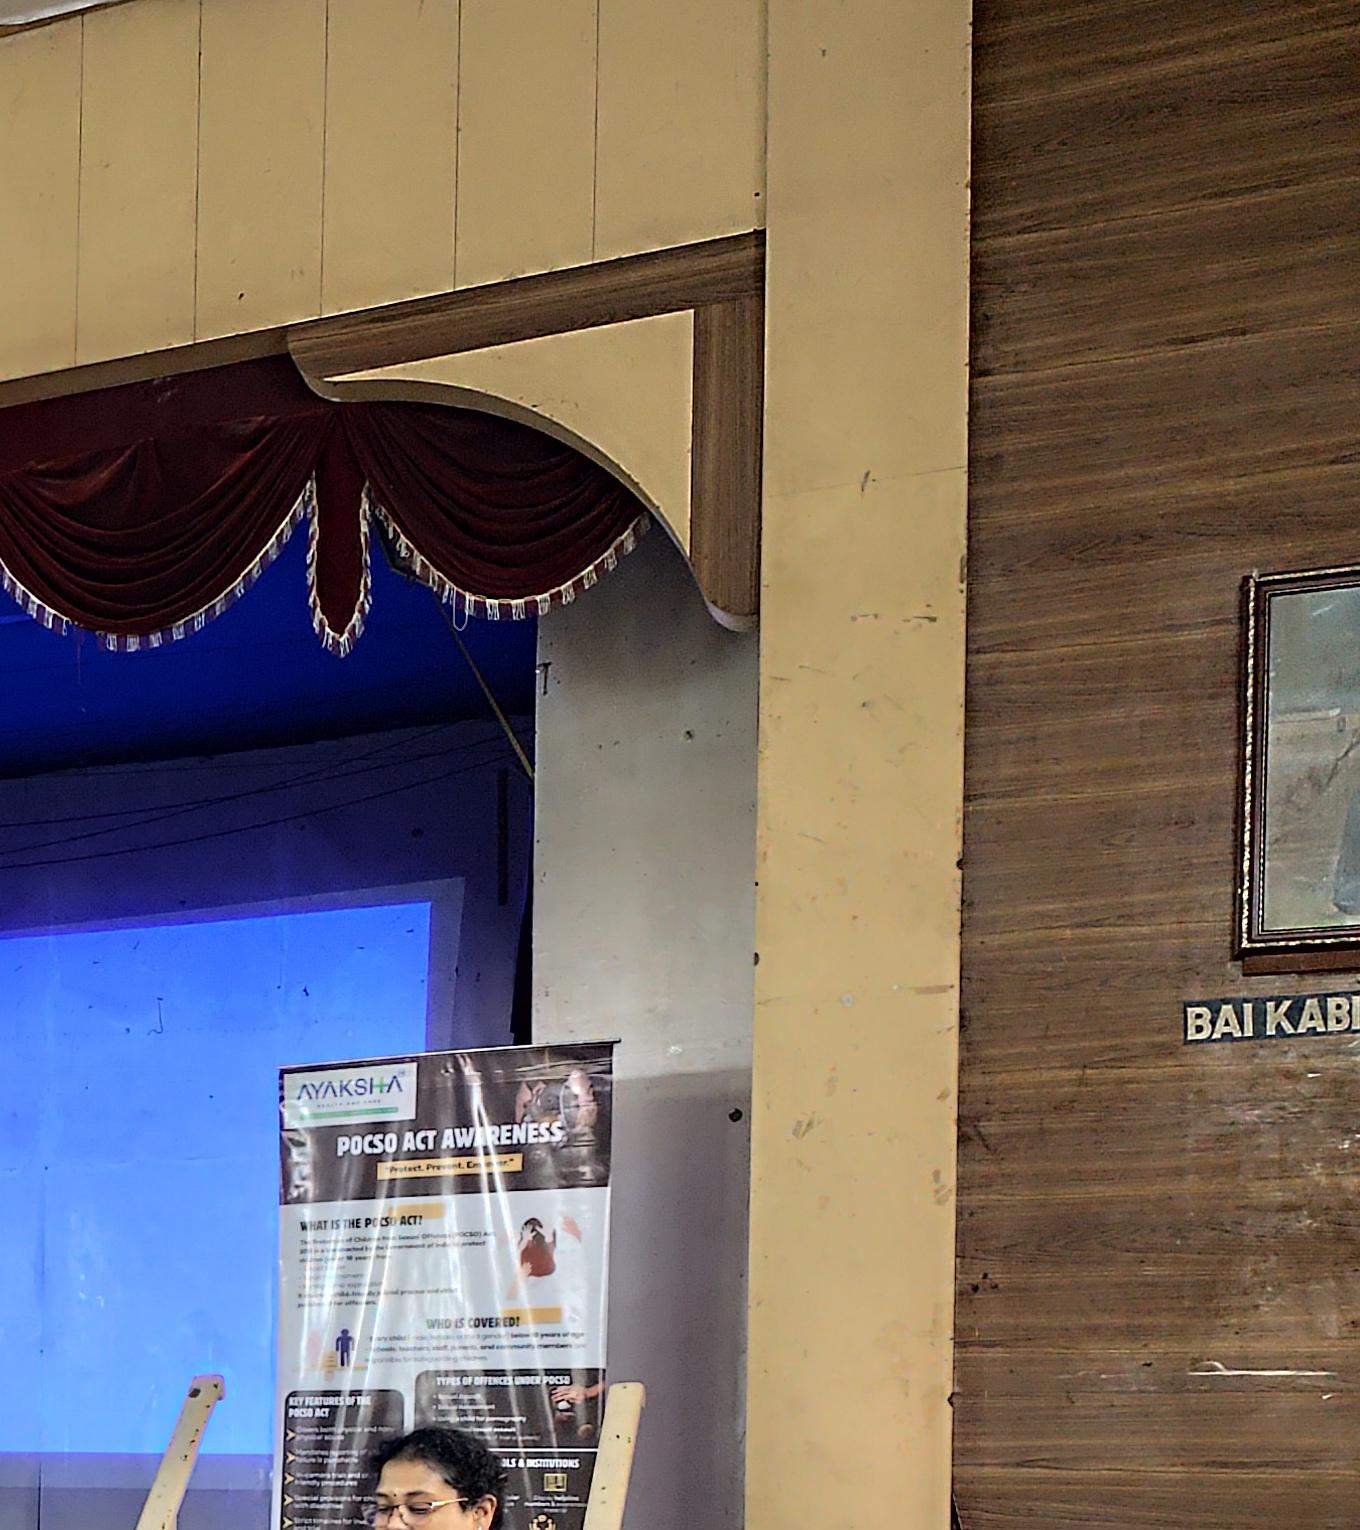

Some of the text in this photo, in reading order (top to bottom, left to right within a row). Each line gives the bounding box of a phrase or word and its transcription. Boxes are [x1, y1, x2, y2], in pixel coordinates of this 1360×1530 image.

[1186, 1003, 1253, 1041] BAI
[296, 1075, 403, 1100] AYAKSHA
[336, 1132, 398, 1156] POCSO
[401, 1129, 438, 1152] ACT
[300, 1219, 328, 1231] WHAT
[331, 1219, 340, 1230] IS
[344, 1217, 361, 1229] THE
[426, 1318, 452, 1329] WHO
[455, 1318, 464, 1328] IS
[436, 1375, 571, 1386] TYPES OF OFFENCES UNDER POCSO
[288, 1395, 372, 1406] KEY FEATURES OF THE
[288, 1407, 331, 1418] POCSO ACT
[518, 1458, 525, 1468] &
[526, 1458, 580, 1468] INSTITUTIONS
